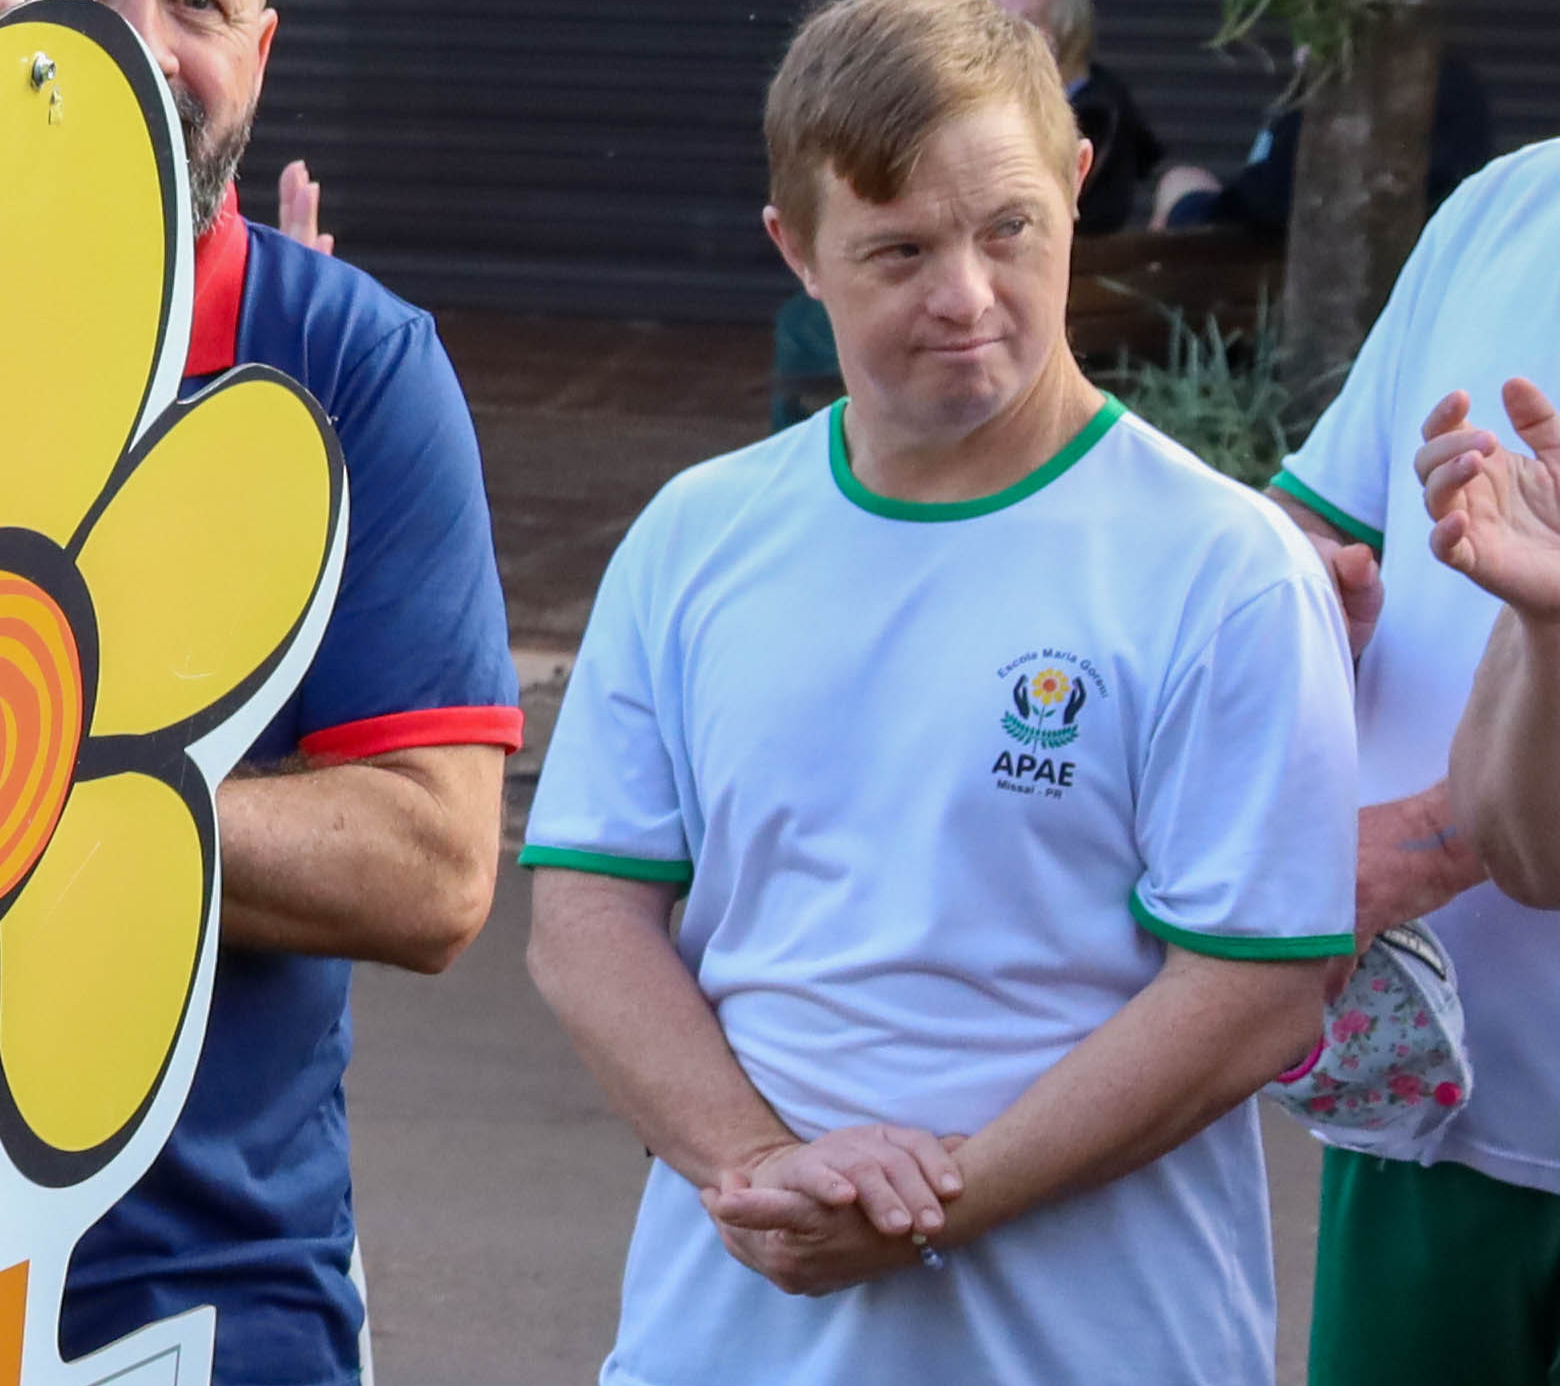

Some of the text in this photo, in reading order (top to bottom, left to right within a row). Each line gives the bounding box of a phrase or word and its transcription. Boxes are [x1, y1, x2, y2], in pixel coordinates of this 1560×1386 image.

[997, 651, 1038, 679] Escola
[1042, 648, 1078, 663] Maria
[991, 749, 1076, 787] APAE
[996, 779, 1035, 795] Missal
[1045, 787, 1063, 800] PR
